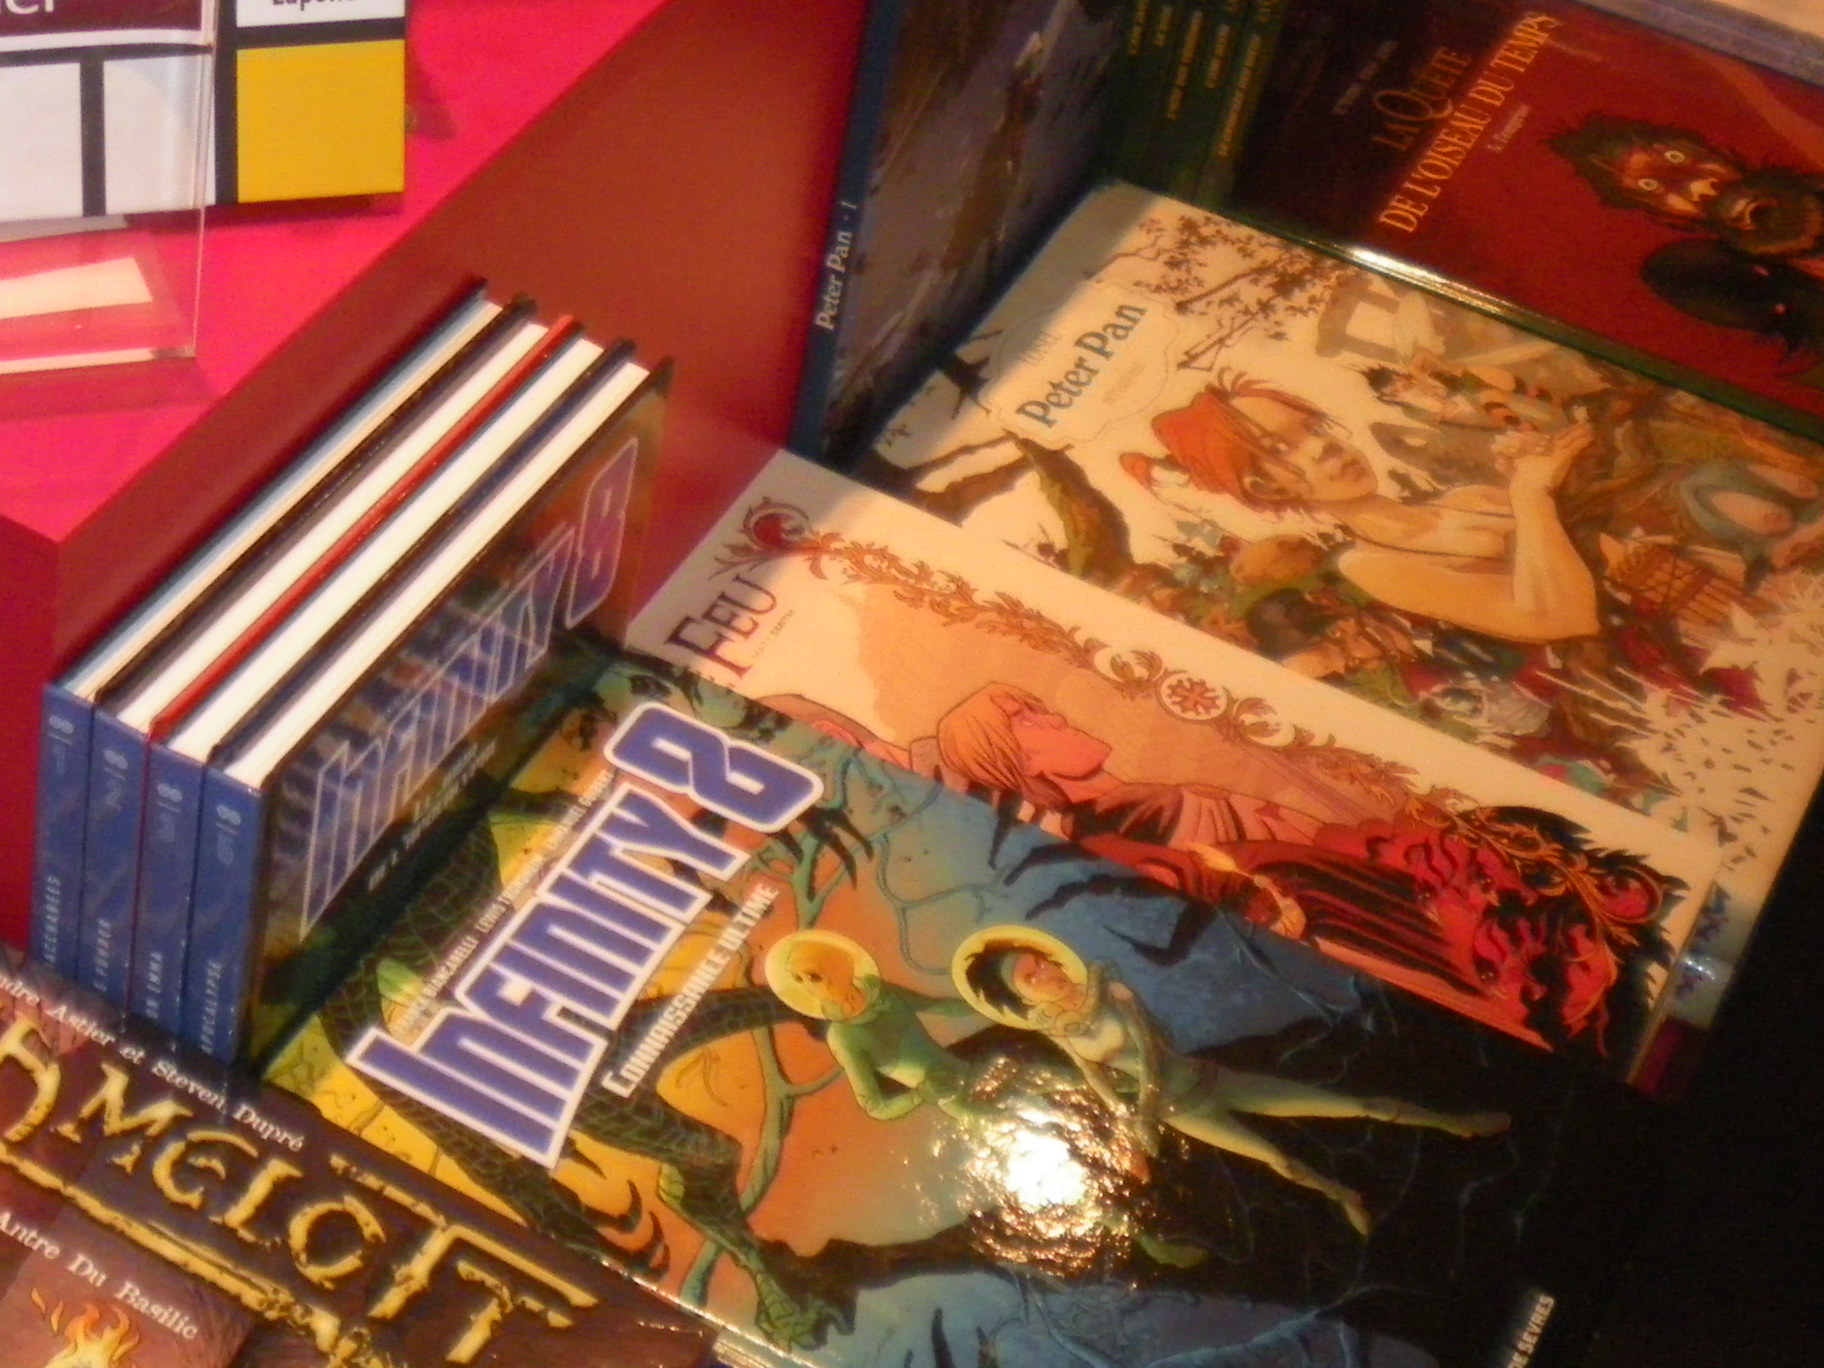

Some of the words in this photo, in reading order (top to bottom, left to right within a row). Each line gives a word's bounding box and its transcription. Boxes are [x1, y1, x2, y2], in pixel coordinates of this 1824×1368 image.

[1486, 0, 1563, 84] TEMPS
[1467, 64, 1517, 114] DU
[1400, 96, 1498, 207] L'OISEAU
[823, 228, 858, 274] Pan
[1376, 185, 1431, 241] DE
[813, 274, 850, 331] Peter
[1016, 345, 1101, 430] Peter
[1082, 301, 1150, 363] Pan
[663, 572, 778, 679] FEU
[42, 873, 63, 968] ACCHABEES
[343, 781, 750, 1170] INFINITY
[603, 700, 825, 834] 8
[474, 900, 507, 935] LEWIS
[716, 880, 781, 954] ULTIME
[48, 1000, 119, 1051] Astier
[118, 1042, 147, 1067] et
[150, 1056, 228, 1112] Steven
[230, 1101, 307, 1159] Dupré
[66, 1252, 112, 1290] Du
[113, 1279, 202, 1343] Basilic
